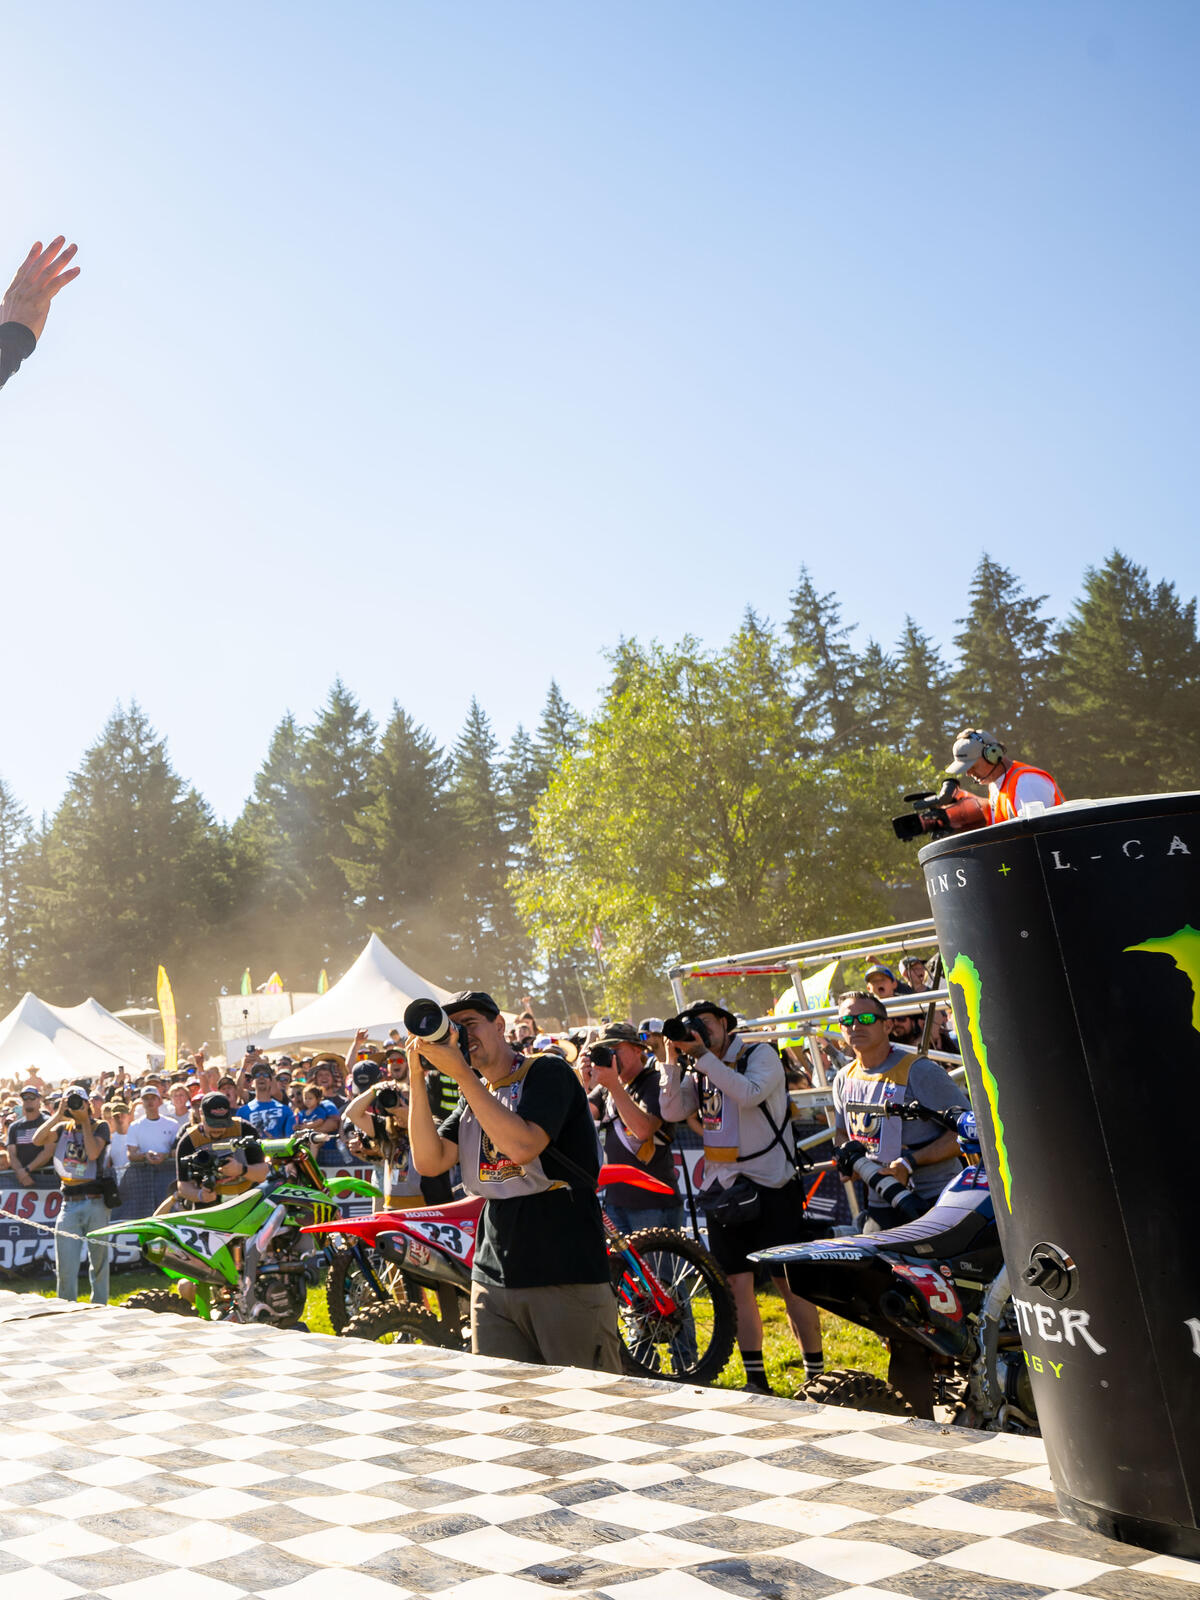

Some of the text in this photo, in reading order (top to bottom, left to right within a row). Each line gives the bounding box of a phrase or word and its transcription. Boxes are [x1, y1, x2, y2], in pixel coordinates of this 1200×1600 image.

[420, 1223, 463, 1254] 23
[811, 1252, 863, 1261] DUNLOP
[908, 1266, 957, 1314] 3
